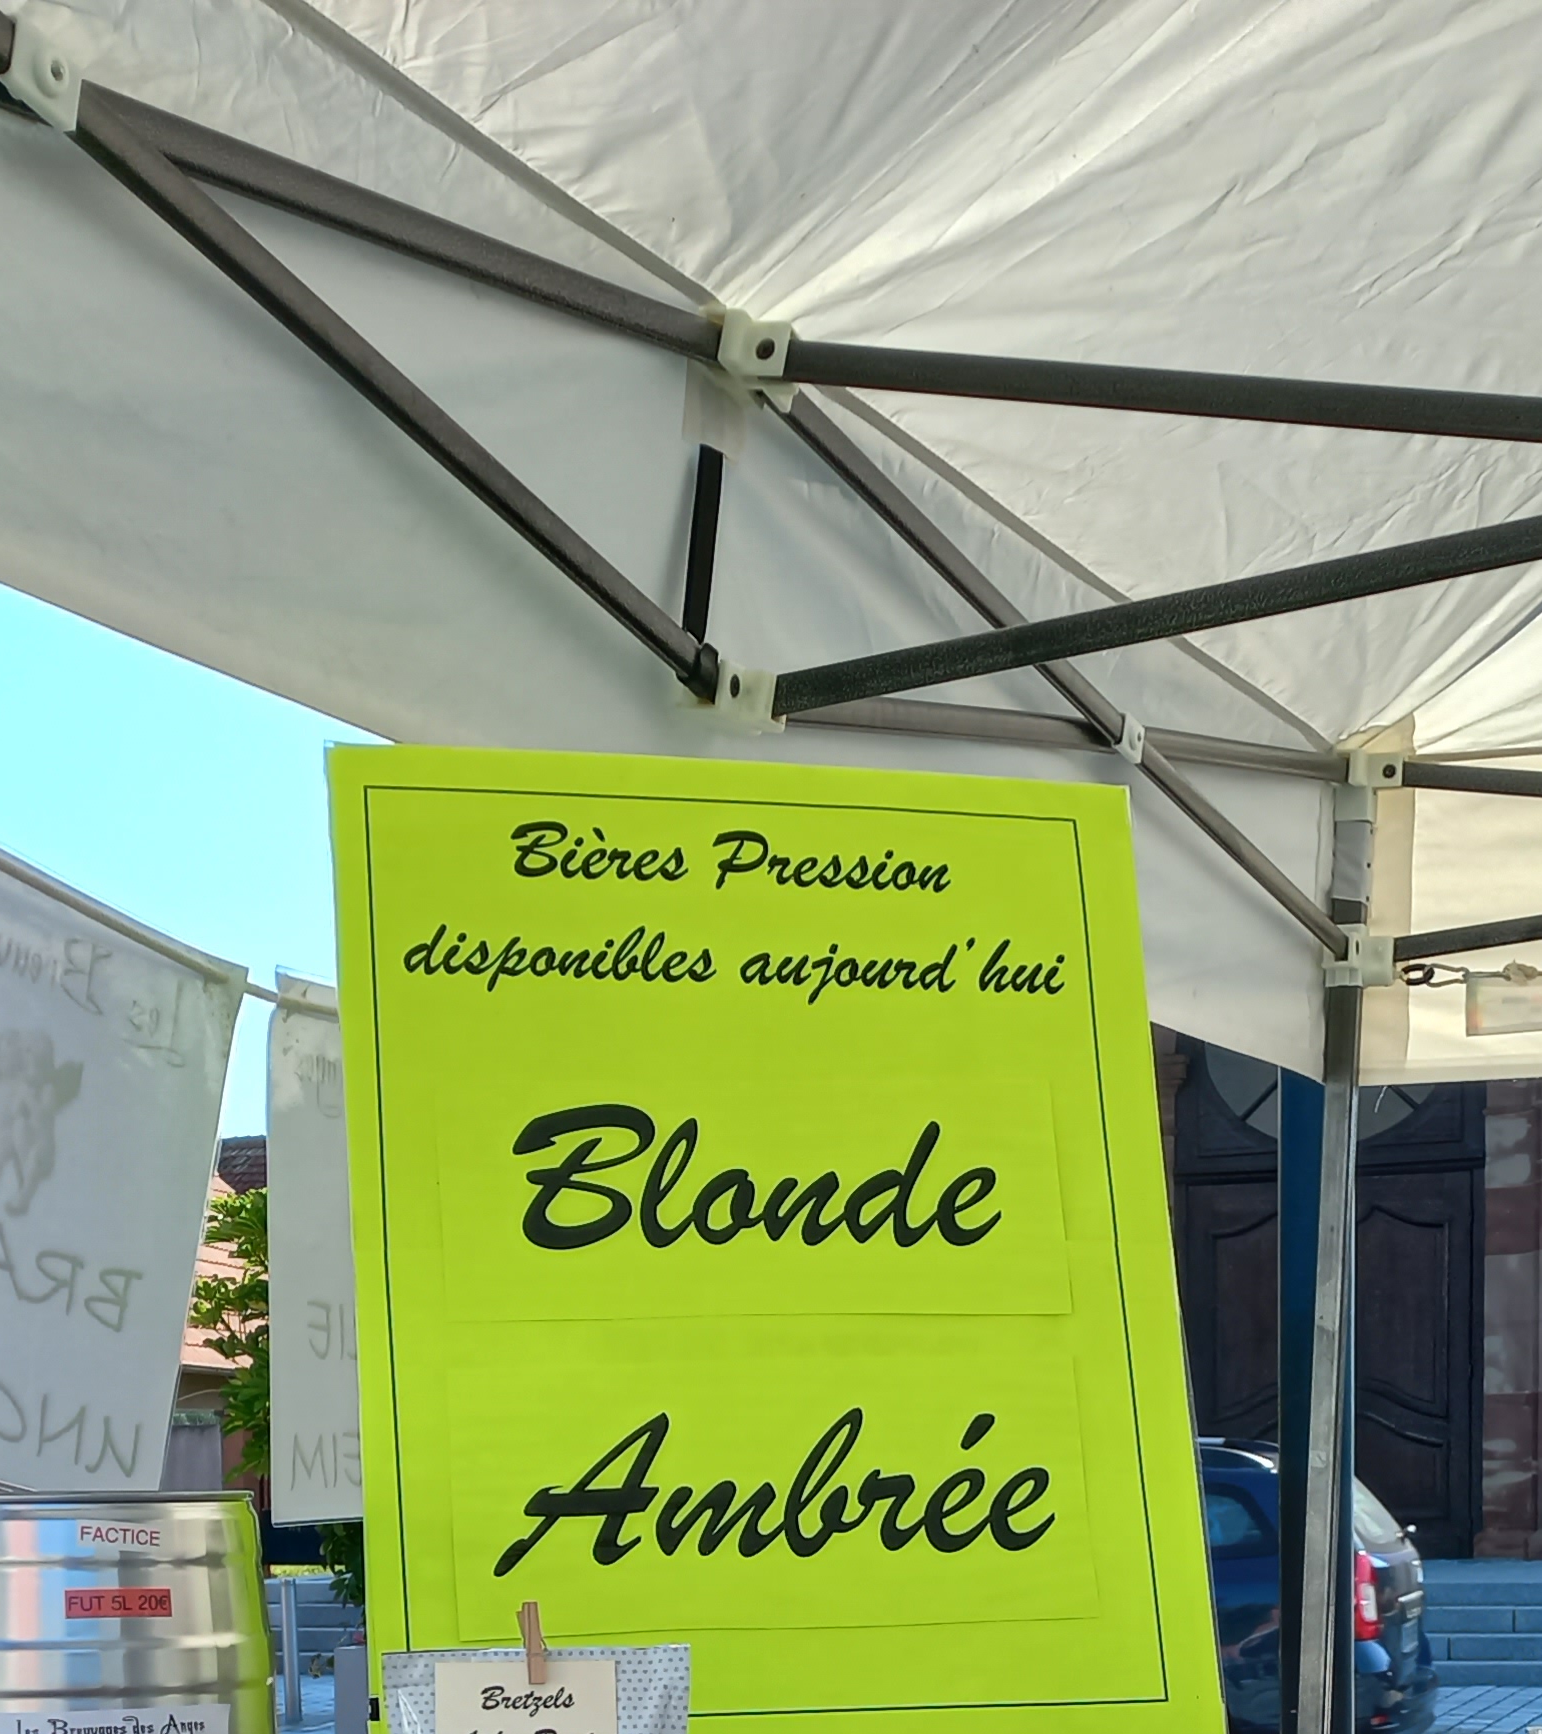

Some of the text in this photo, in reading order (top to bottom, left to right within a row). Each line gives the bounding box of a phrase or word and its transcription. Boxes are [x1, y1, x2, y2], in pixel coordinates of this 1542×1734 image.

[511, 821, 951, 894] Bières Pression
[404, 924, 1067, 1005] disponibles aujourd'hui
[512, 1102, 1002, 1252] Blonde
[493, 1407, 1057, 1578] Ambrée
[80, 1525, 161, 1547] FACTICE
[68, 1595, 169, 1611] FUT 5L 20€
[122, 1716, 154, 1734] des
[480, 1685, 575, 1719] Bretzels
